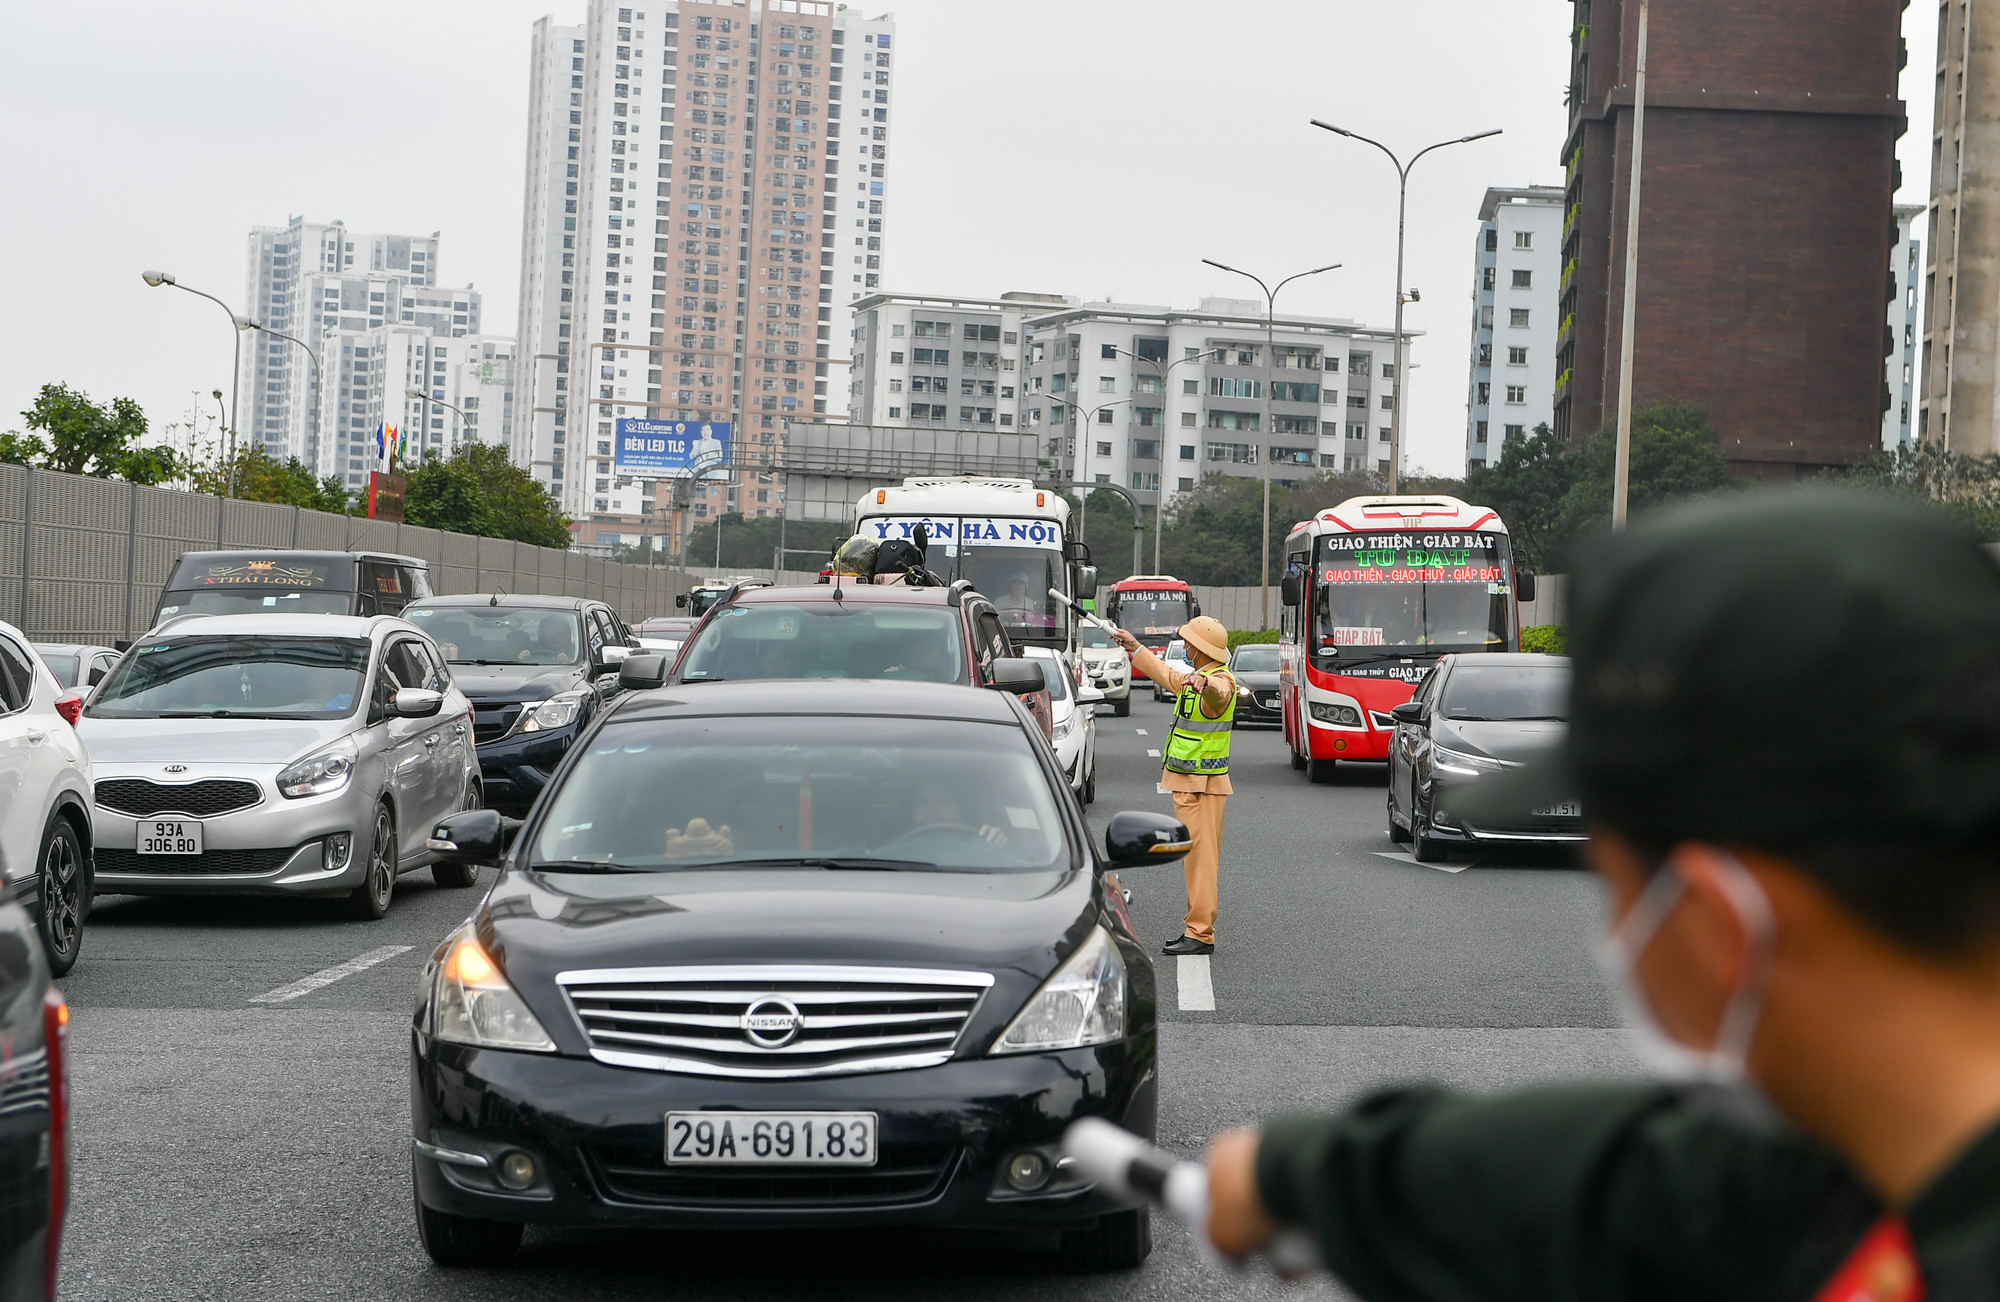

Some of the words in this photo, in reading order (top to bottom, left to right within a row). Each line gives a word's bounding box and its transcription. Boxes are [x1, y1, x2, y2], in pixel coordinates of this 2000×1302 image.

[637, 422, 650, 430] TLC
[624, 436, 645, 452] ĐÈN
[647, 439, 666, 453] LED
[668, 440, 685, 454] TLC
[1403, 518, 1422, 528] VIP
[874, 517, 893, 539] Ý
[963, 519, 1001, 539] HÀ
[1009, 521, 1056, 545] NỘI
[1328, 536, 1365, 550] GIAO
[1368, 533, 1413, 551] THIỆN
[1423, 533, 1460, 548] GIÁP
[1464, 533, 1494, 549] BÁT
[1325, 569, 1351, 582] GIAO
[1352, 567, 1383, 583] THIỆN
[1391, 569, 1417, 581] GIAO
[1453, 566, 1478, 581] GIÁP
[1480, 565, 1500, 580] BÁT
[263, 576, 312, 587] LONG
[1160, 591, 1171, 601] HÀ
[1172, 591, 1186, 602] NỘI
[1335, 628, 1358, 645] GIÁP
[1362, 629, 1382, 645] BÁT
[1389, 667, 1413, 678] GIAO
[156, 823, 184, 836] 93A
[144, 838, 196, 852] 306.80
[747, 1018, 798, 1027] NISSAN
[672, 1120, 868, 1158] 29A-691.83
